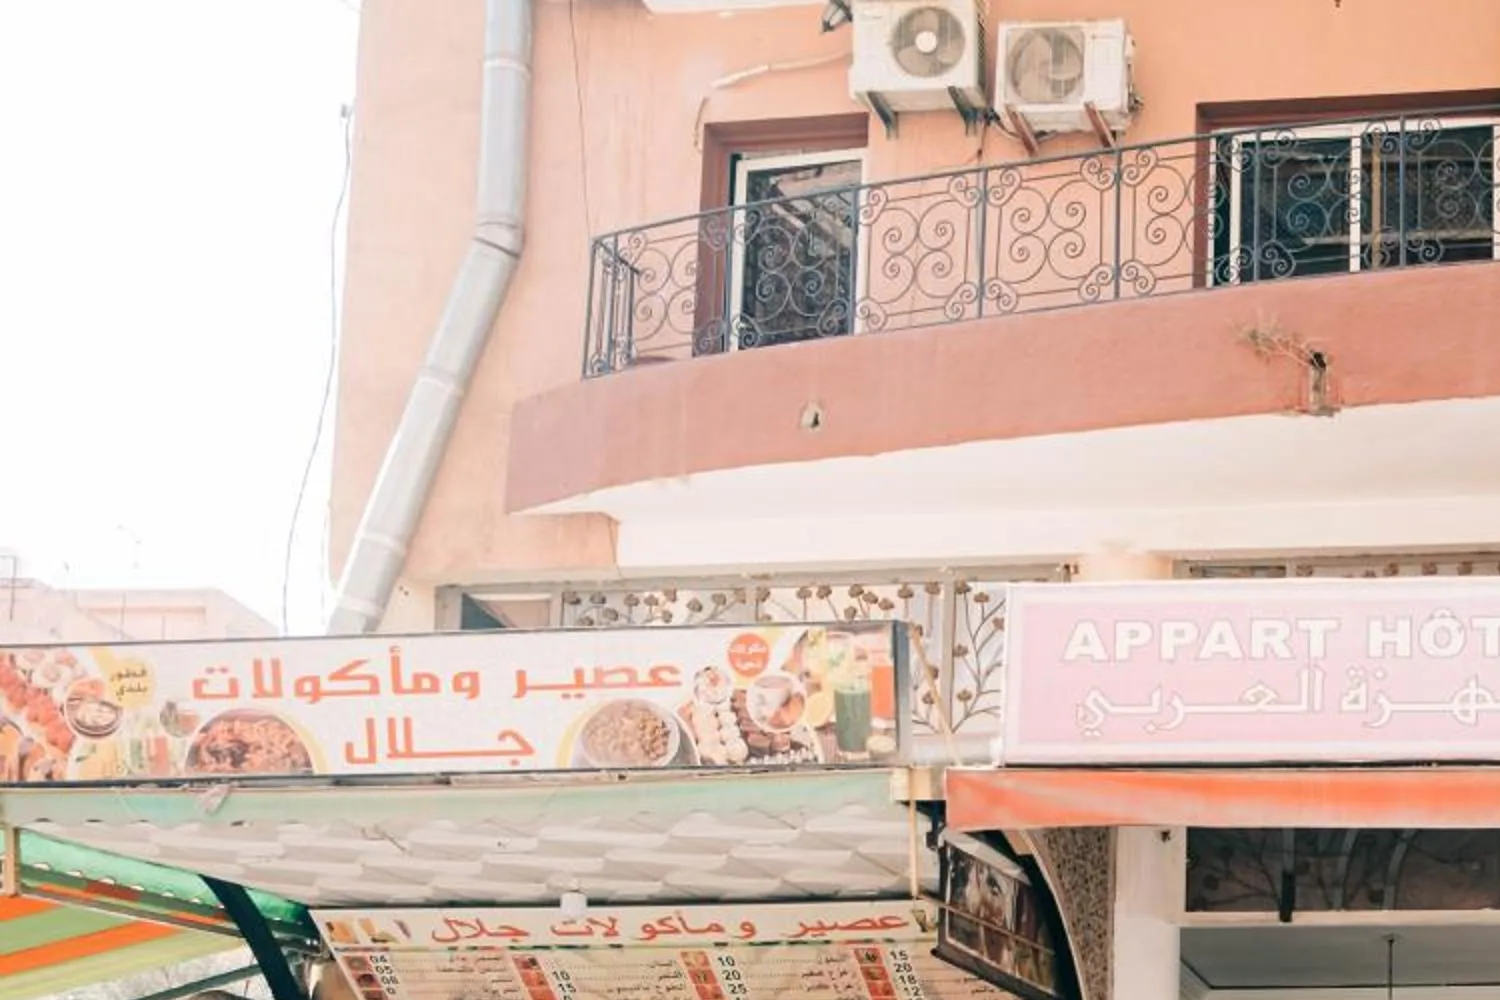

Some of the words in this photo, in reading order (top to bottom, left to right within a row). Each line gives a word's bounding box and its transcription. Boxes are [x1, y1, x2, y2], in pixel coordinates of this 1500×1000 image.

[1061, 617, 1342, 663] APPART
[513, 664, 682, 699] عصير
[1075, 664, 1326, 737] العربي
[344, 716, 536, 767] جلال
[431, 917, 532, 943] جلال
[785, 914, 909, 939] عصير
[717, 955, 736, 967] 10
[722, 969, 741, 981] 20
[728, 983, 748, 995] 25
